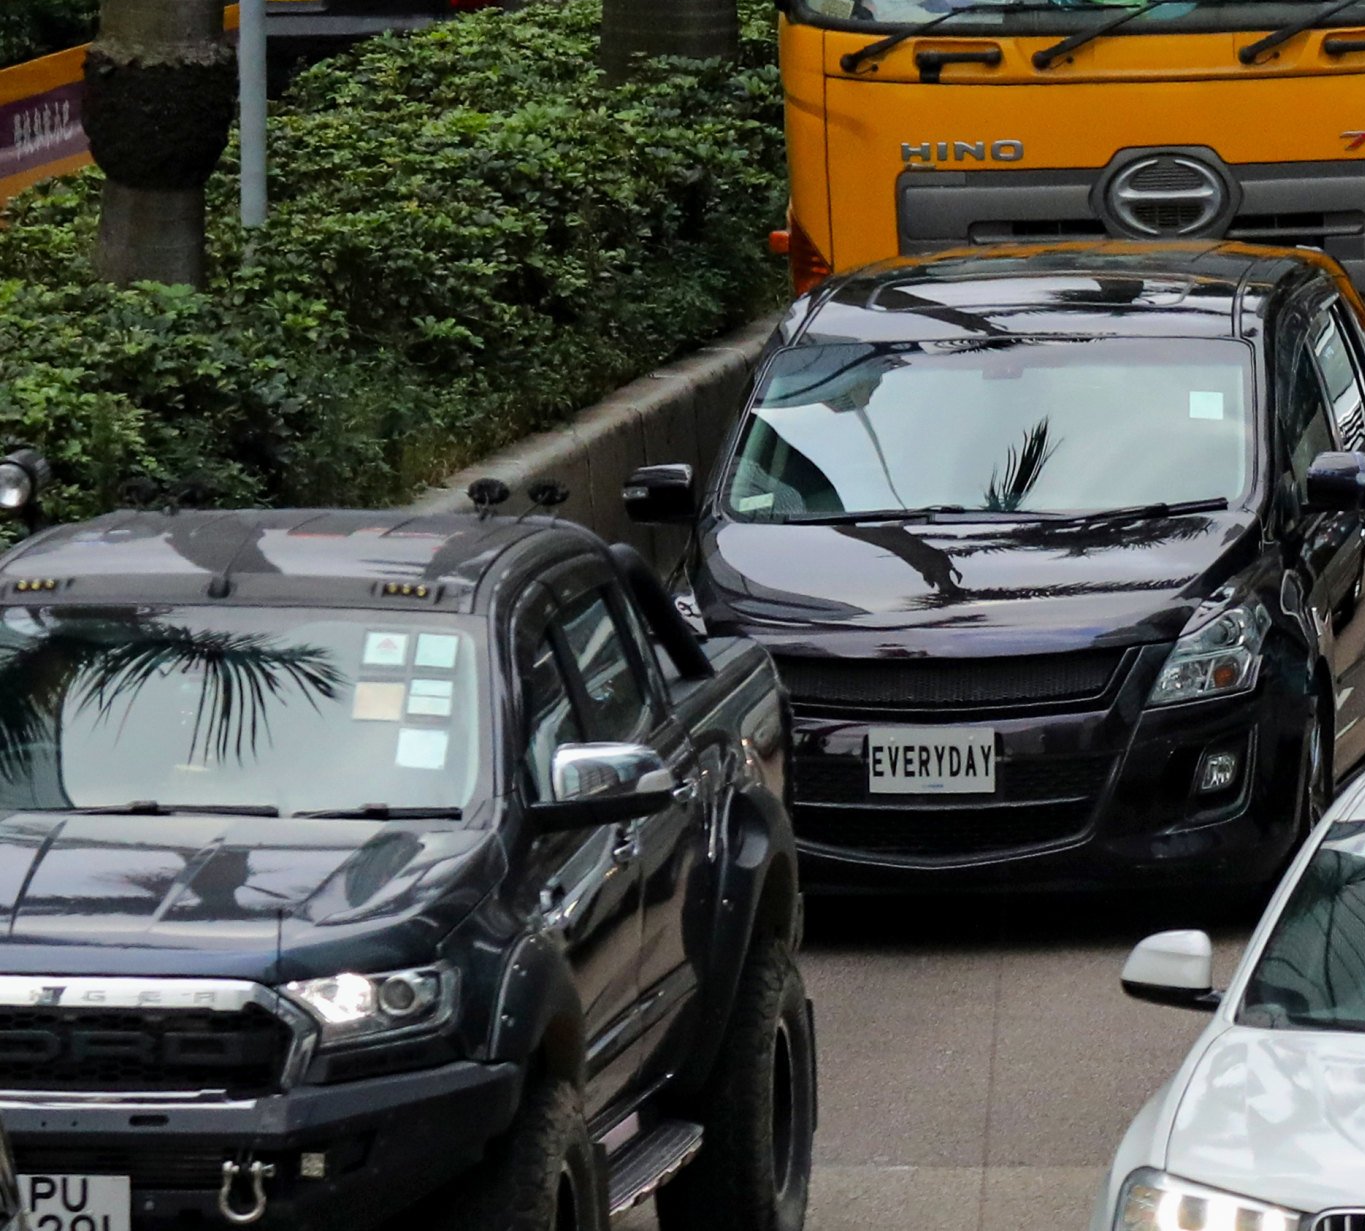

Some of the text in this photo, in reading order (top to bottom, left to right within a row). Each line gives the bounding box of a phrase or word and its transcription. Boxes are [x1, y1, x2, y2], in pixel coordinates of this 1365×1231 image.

[901, 140, 1024, 161] HINO
[872, 745, 992, 777] EVERYDAY
[31, 1176, 88, 1213] PU
